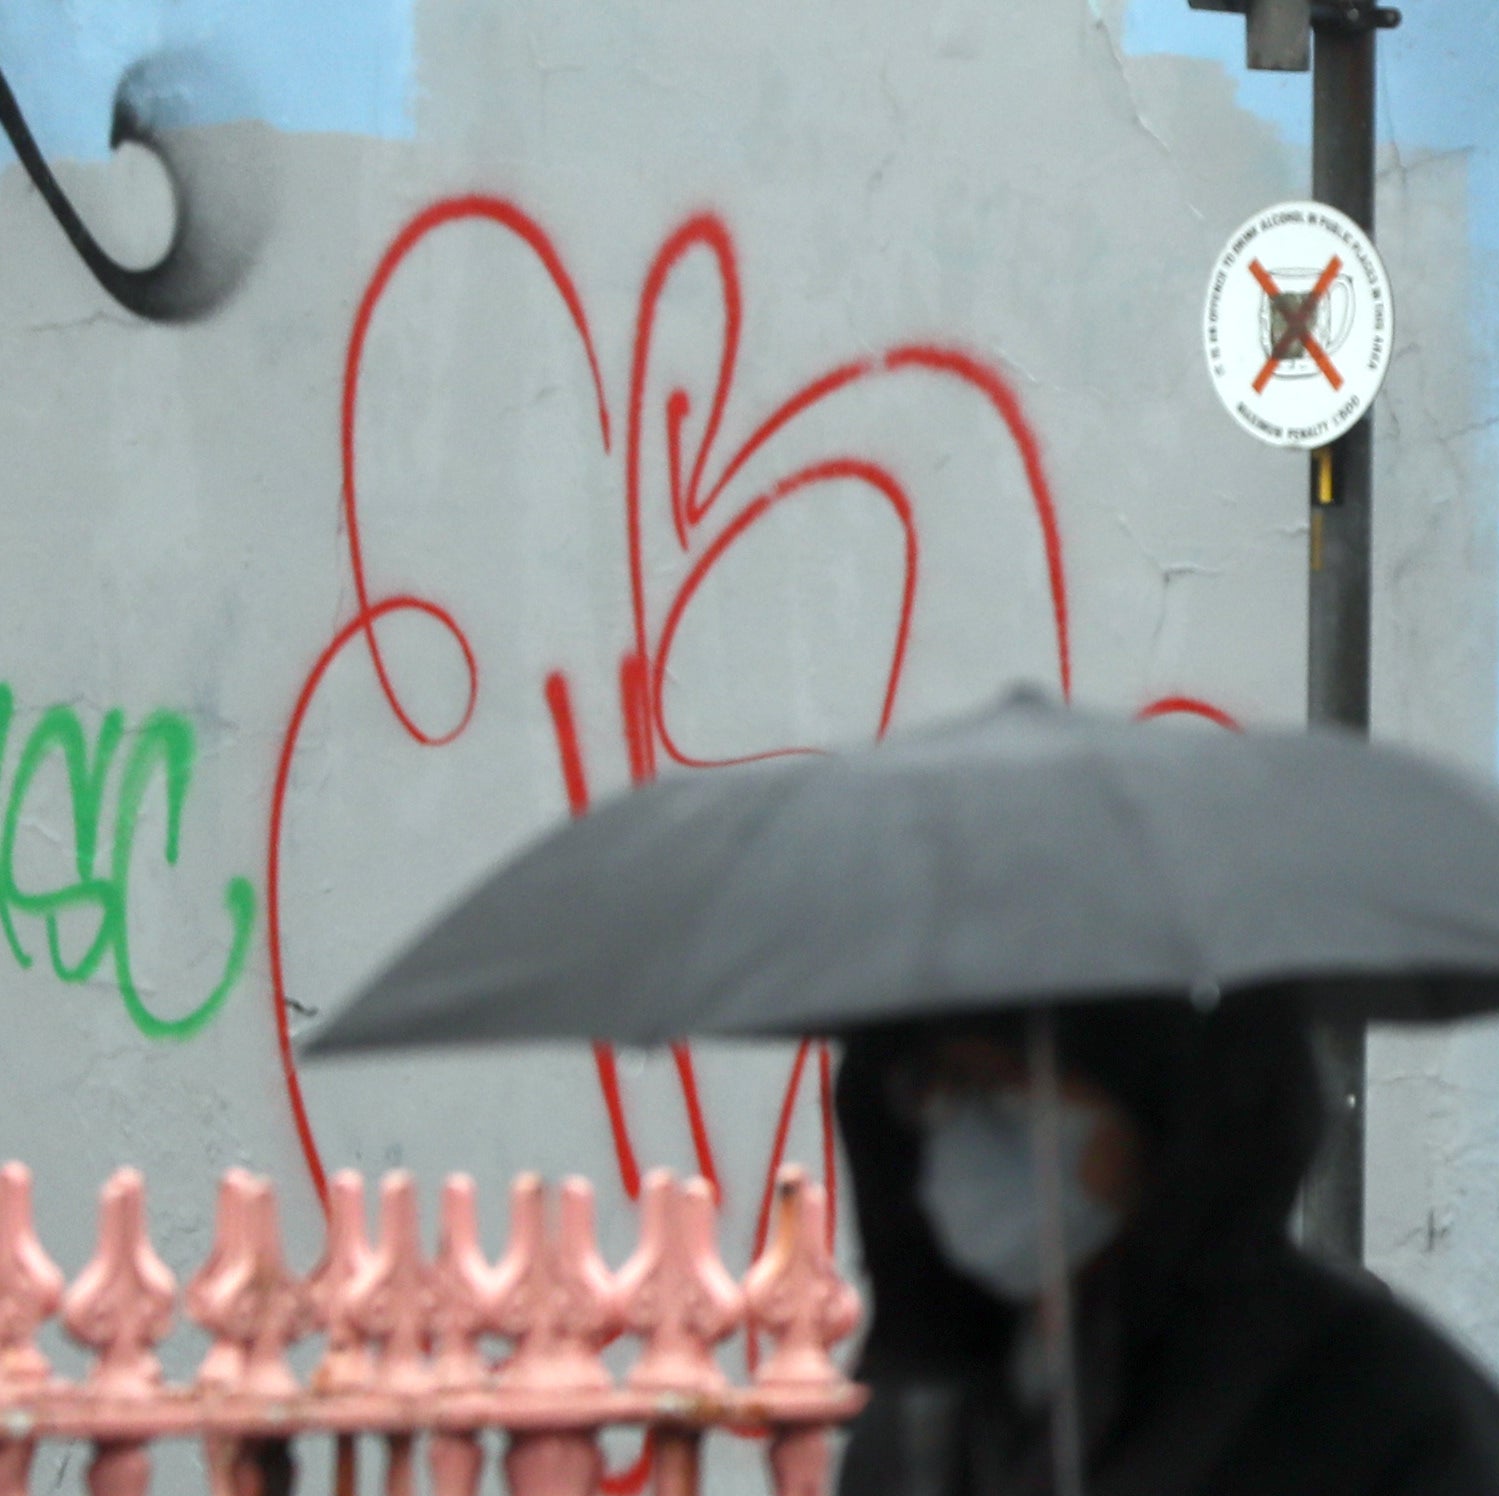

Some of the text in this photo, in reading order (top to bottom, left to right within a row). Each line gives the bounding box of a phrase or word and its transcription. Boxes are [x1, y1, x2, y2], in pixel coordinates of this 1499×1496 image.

[1207, 271, 1227, 322] OFFENCE
[1222, 252, 1236, 268] TO
[1231, 226, 1259, 255] DRINK
[1260, 209, 1304, 232] ALCOHOL
[1319, 214, 1354, 244] PUBLIC
[1350, 239, 1379, 285] PLACES
[1366, 334, 1385, 370] AREA
[1236, 400, 1283, 438] MAXIMUM
[1286, 420, 1330, 440] PENALTY
